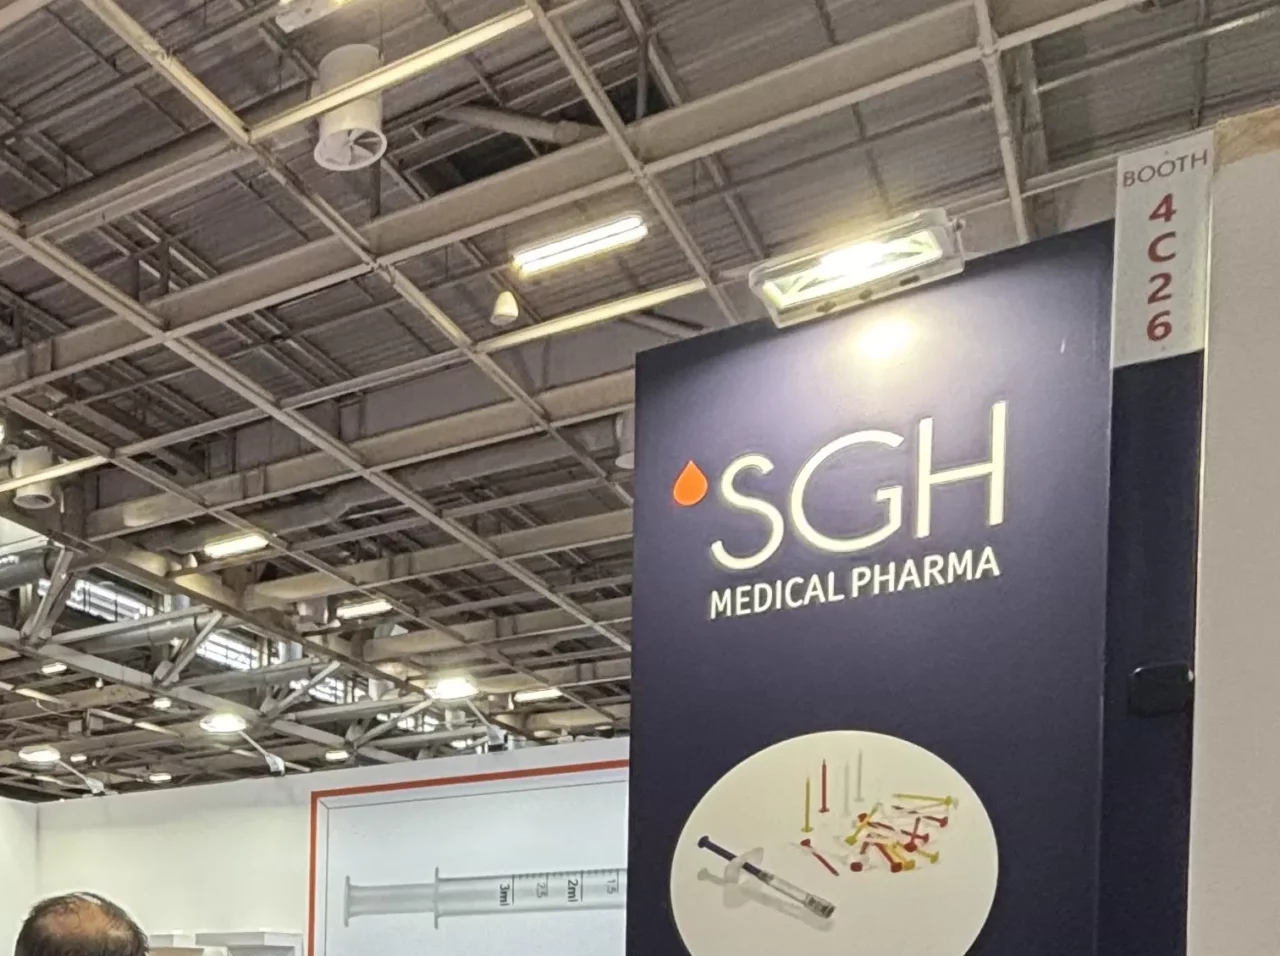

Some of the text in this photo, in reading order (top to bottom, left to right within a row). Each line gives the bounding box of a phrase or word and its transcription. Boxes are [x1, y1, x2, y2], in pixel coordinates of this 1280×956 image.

[1122, 149, 1208, 188] BOOTH
[710, 401, 1007, 571] SGH
[710, 546, 1000, 620] MEDICAL PHARMA
[567, 879, 579, 902] 2ml
